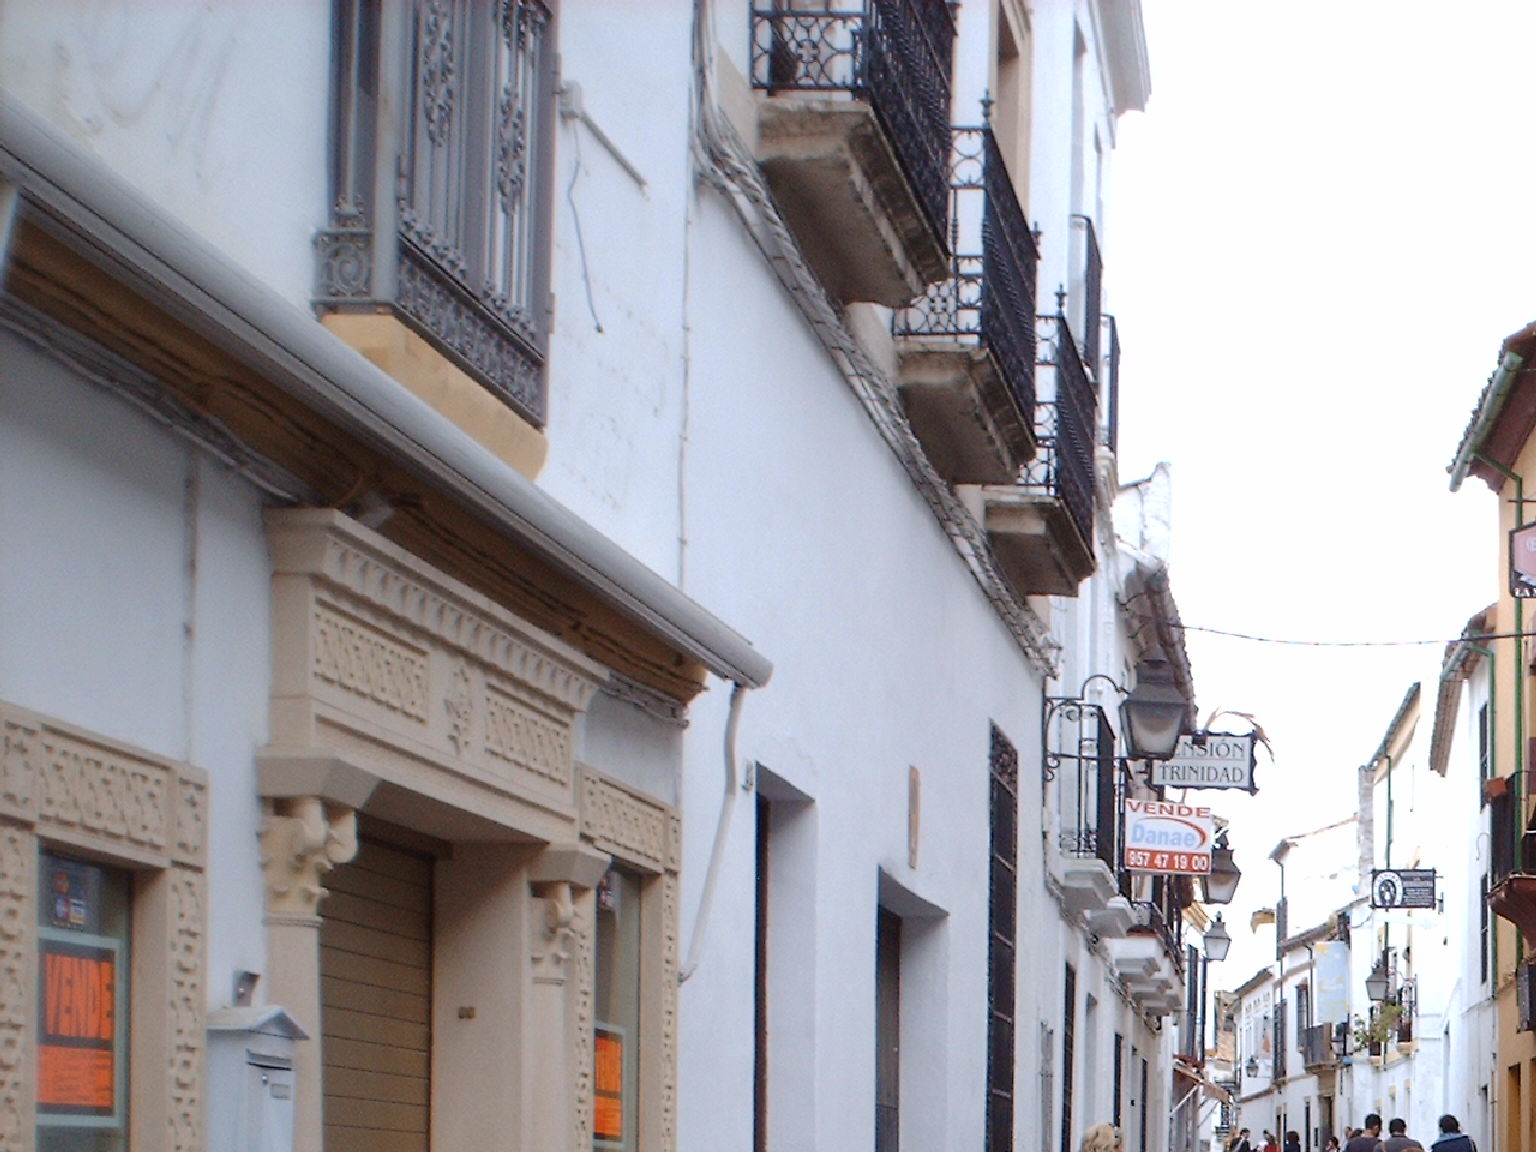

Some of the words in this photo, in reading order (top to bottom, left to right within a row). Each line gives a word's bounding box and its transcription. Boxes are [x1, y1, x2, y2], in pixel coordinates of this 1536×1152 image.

[1515, 587, 1530, 597] LA
[1159, 763, 1245, 783] TRINIDAD
[1127, 801, 1211, 818] VENDE
[1131, 824, 1198, 848] Danae
[1129, 851, 1151, 867] 957
[1154, 853, 1169, 868] 47
[1173, 855, 1187, 870] 19
[1192, 856, 1208, 871] 00
